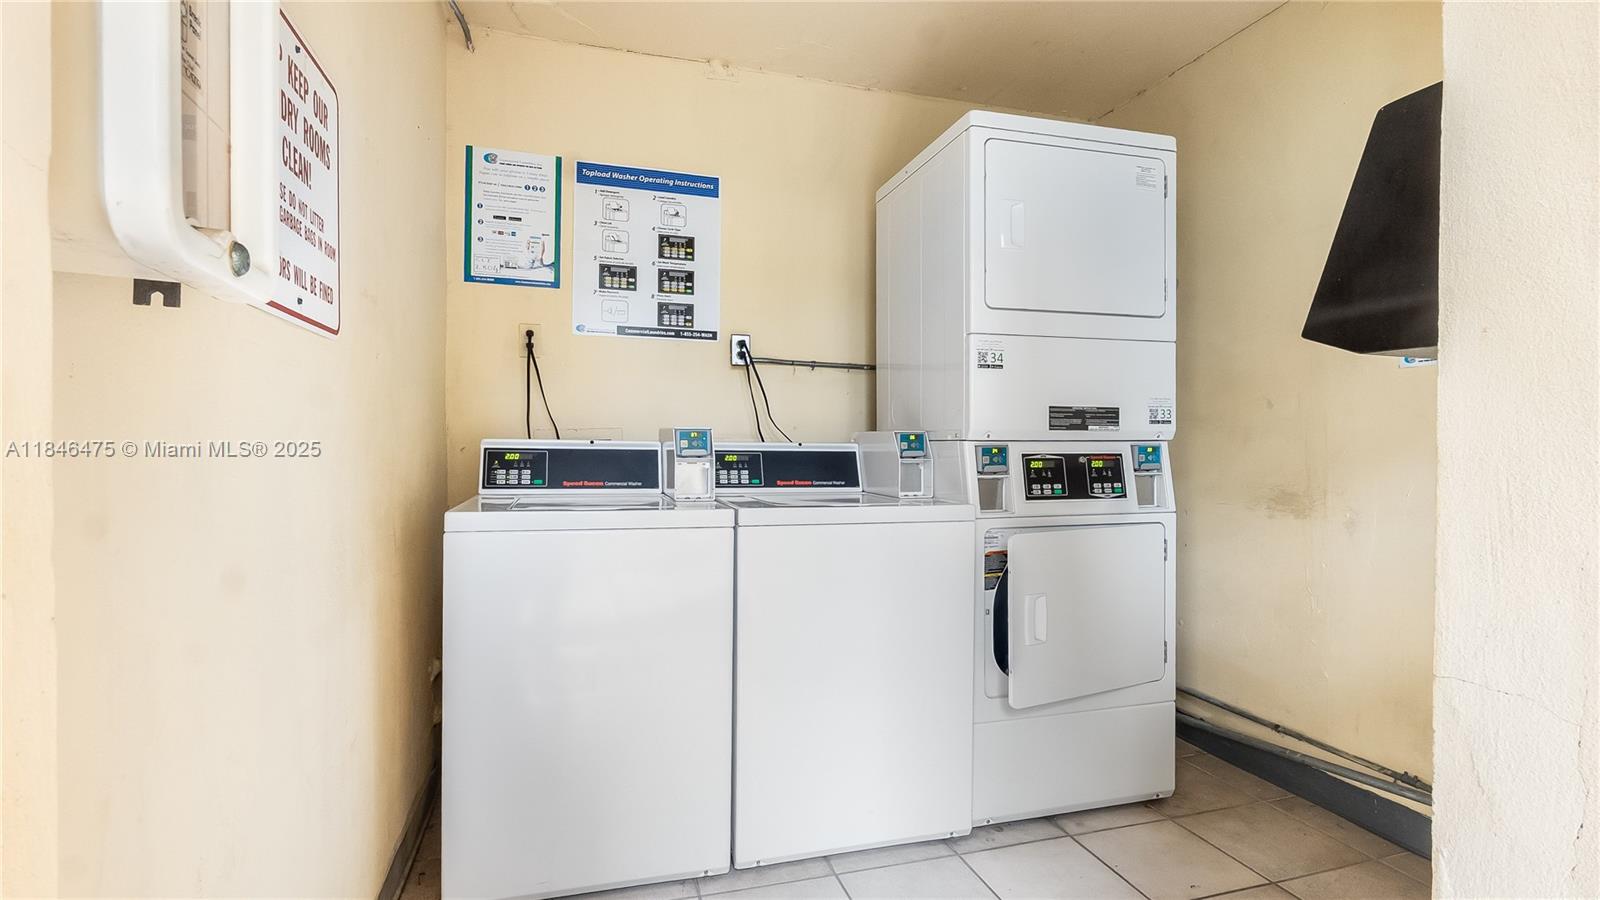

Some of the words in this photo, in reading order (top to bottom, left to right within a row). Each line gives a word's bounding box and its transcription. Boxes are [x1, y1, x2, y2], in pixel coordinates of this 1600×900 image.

[288, 55, 309, 104] KEEP
[313, 90, 328, 132] OUR
[280, 89, 298, 134] DRY
[303, 116, 330, 170] ROOMS
[282, 136, 312, 190] CLEAN!
[582, 168, 611, 178] Topload
[612, 172, 638, 181] Washer
[638, 174, 674, 186] Operating
[674, 180, 714, 190] Instructions
[280, 205, 302, 238] GARBAGE
[304, 224, 316, 248] BAGS
[318, 235, 323, 252] IN
[289, 190, 296, 210] DO
[298, 198, 308, 220] NOT
[310, 208, 324, 234] LITTER
[294, 264, 308, 292] WILL
[310, 274, 318, 296] BE
[320, 280, 334, 304] FINED
[990, 352, 1003, 363] 34
[1160, 409, 1172, 419] 33
